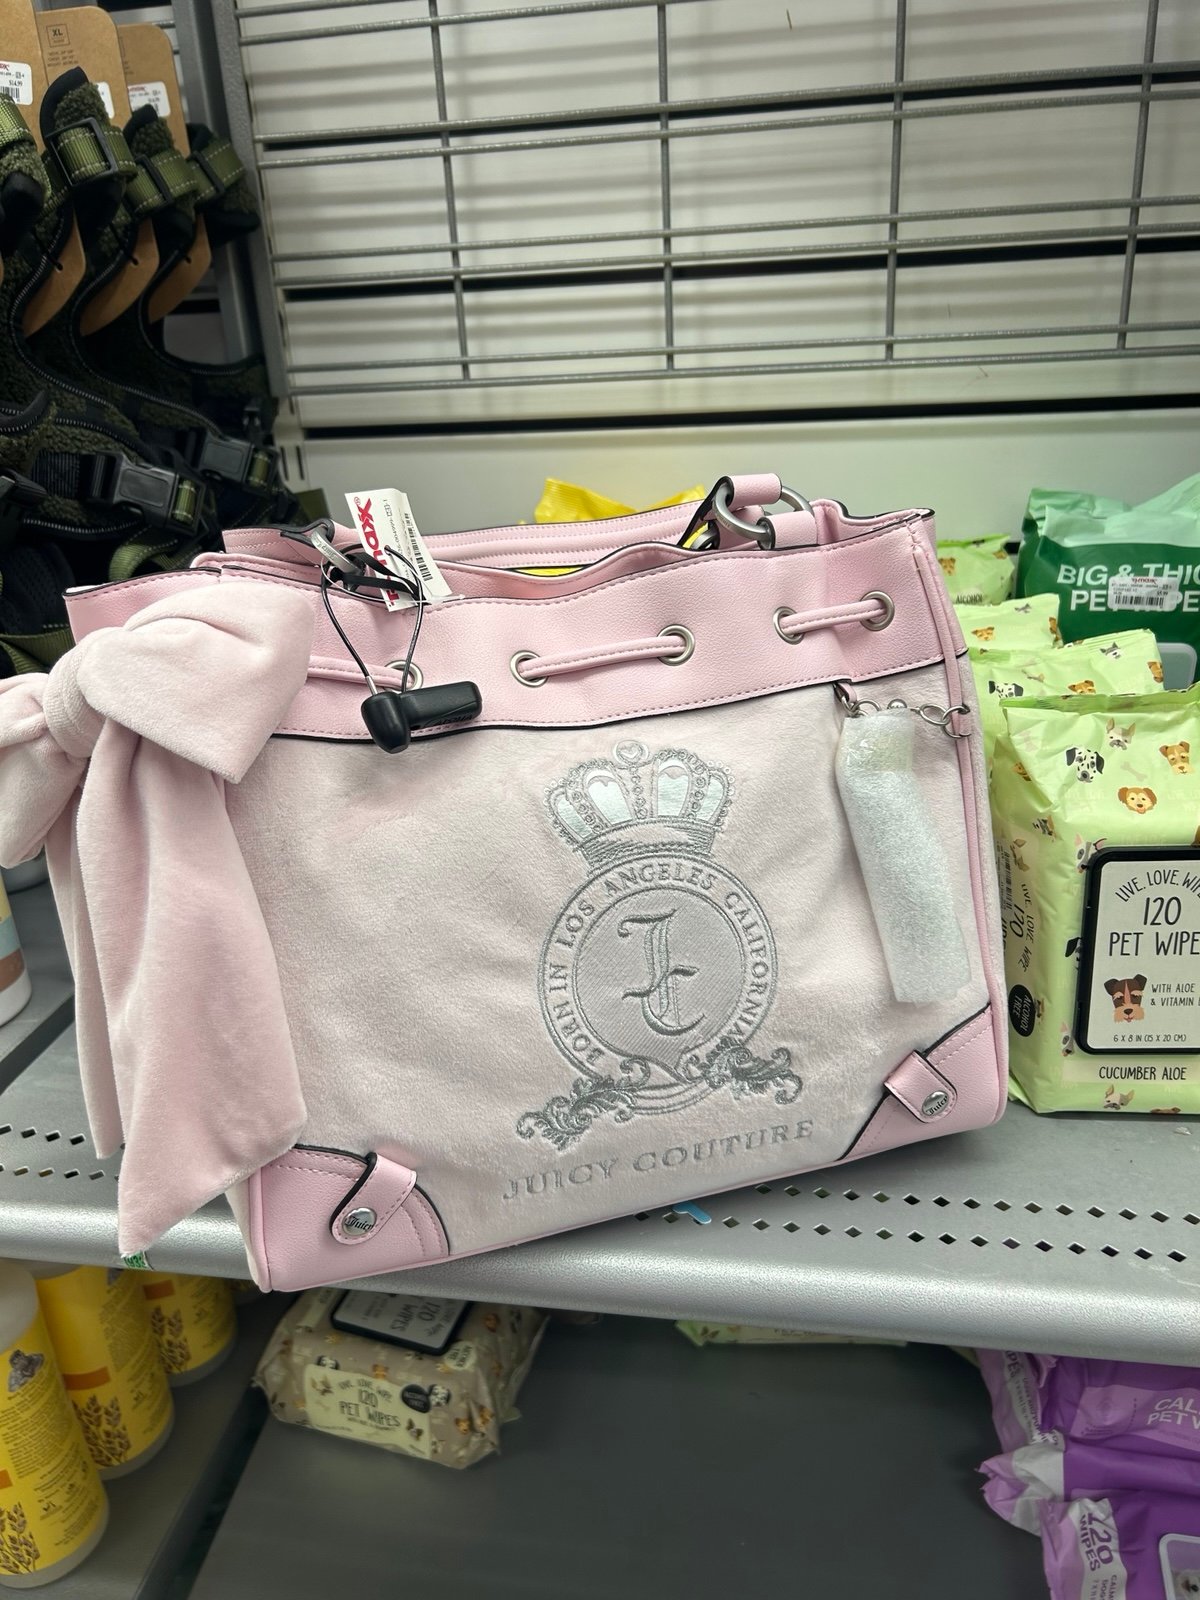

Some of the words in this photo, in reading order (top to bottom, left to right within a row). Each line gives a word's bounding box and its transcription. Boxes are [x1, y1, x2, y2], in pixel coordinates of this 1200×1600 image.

[52, 28, 63, 37] XL
[1057, 564, 1109, 586] BIG
[1116, 564, 1134, 577] &
[603, 863, 718, 896] ANGELES
[1115, 877, 1146, 902] LIVE.
[1147, 869, 1179, 886] LOVE.
[555, 899, 595, 948] LOS
[1143, 896, 1182, 926] 120
[1109, 931, 1144, 957] PET
[549, 963, 568, 993] IN
[724, 891, 769, 1038] CALIFORNIA
[1150, 998, 1156, 1006] &
[1160, 997, 1195, 1007] VITAMIN
[1151, 983, 1172, 993] WITH
[1175, 983, 1196, 993] ALOE
[1012, 994, 1023, 1016] FREE
[553, 1000, 605, 1066] BORN
[1113, 1034, 1119, 1043] 6
[1121, 1034, 1126, 1042] X
[1127, 1034, 1133, 1043] 8
[1156, 1034, 1161, 1042] X
[1162, 1034, 1172, 1042] 20
[1173, 1033, 1187, 1043] CM)
[1098, 1066, 1157, 1080] CUCUMBER
[1161, 1066, 1187, 1080] ALOE
[503, 1156, 620, 1201] JUICY
[632, 1119, 814, 1173] COUTURE
[365, 1406, 401, 1427] WIPES
[1146, 1411, 1188, 1425] PET
[1080, 1514, 1100, 1571] WIPES
[1088, 1512, 1114, 1564] 120
